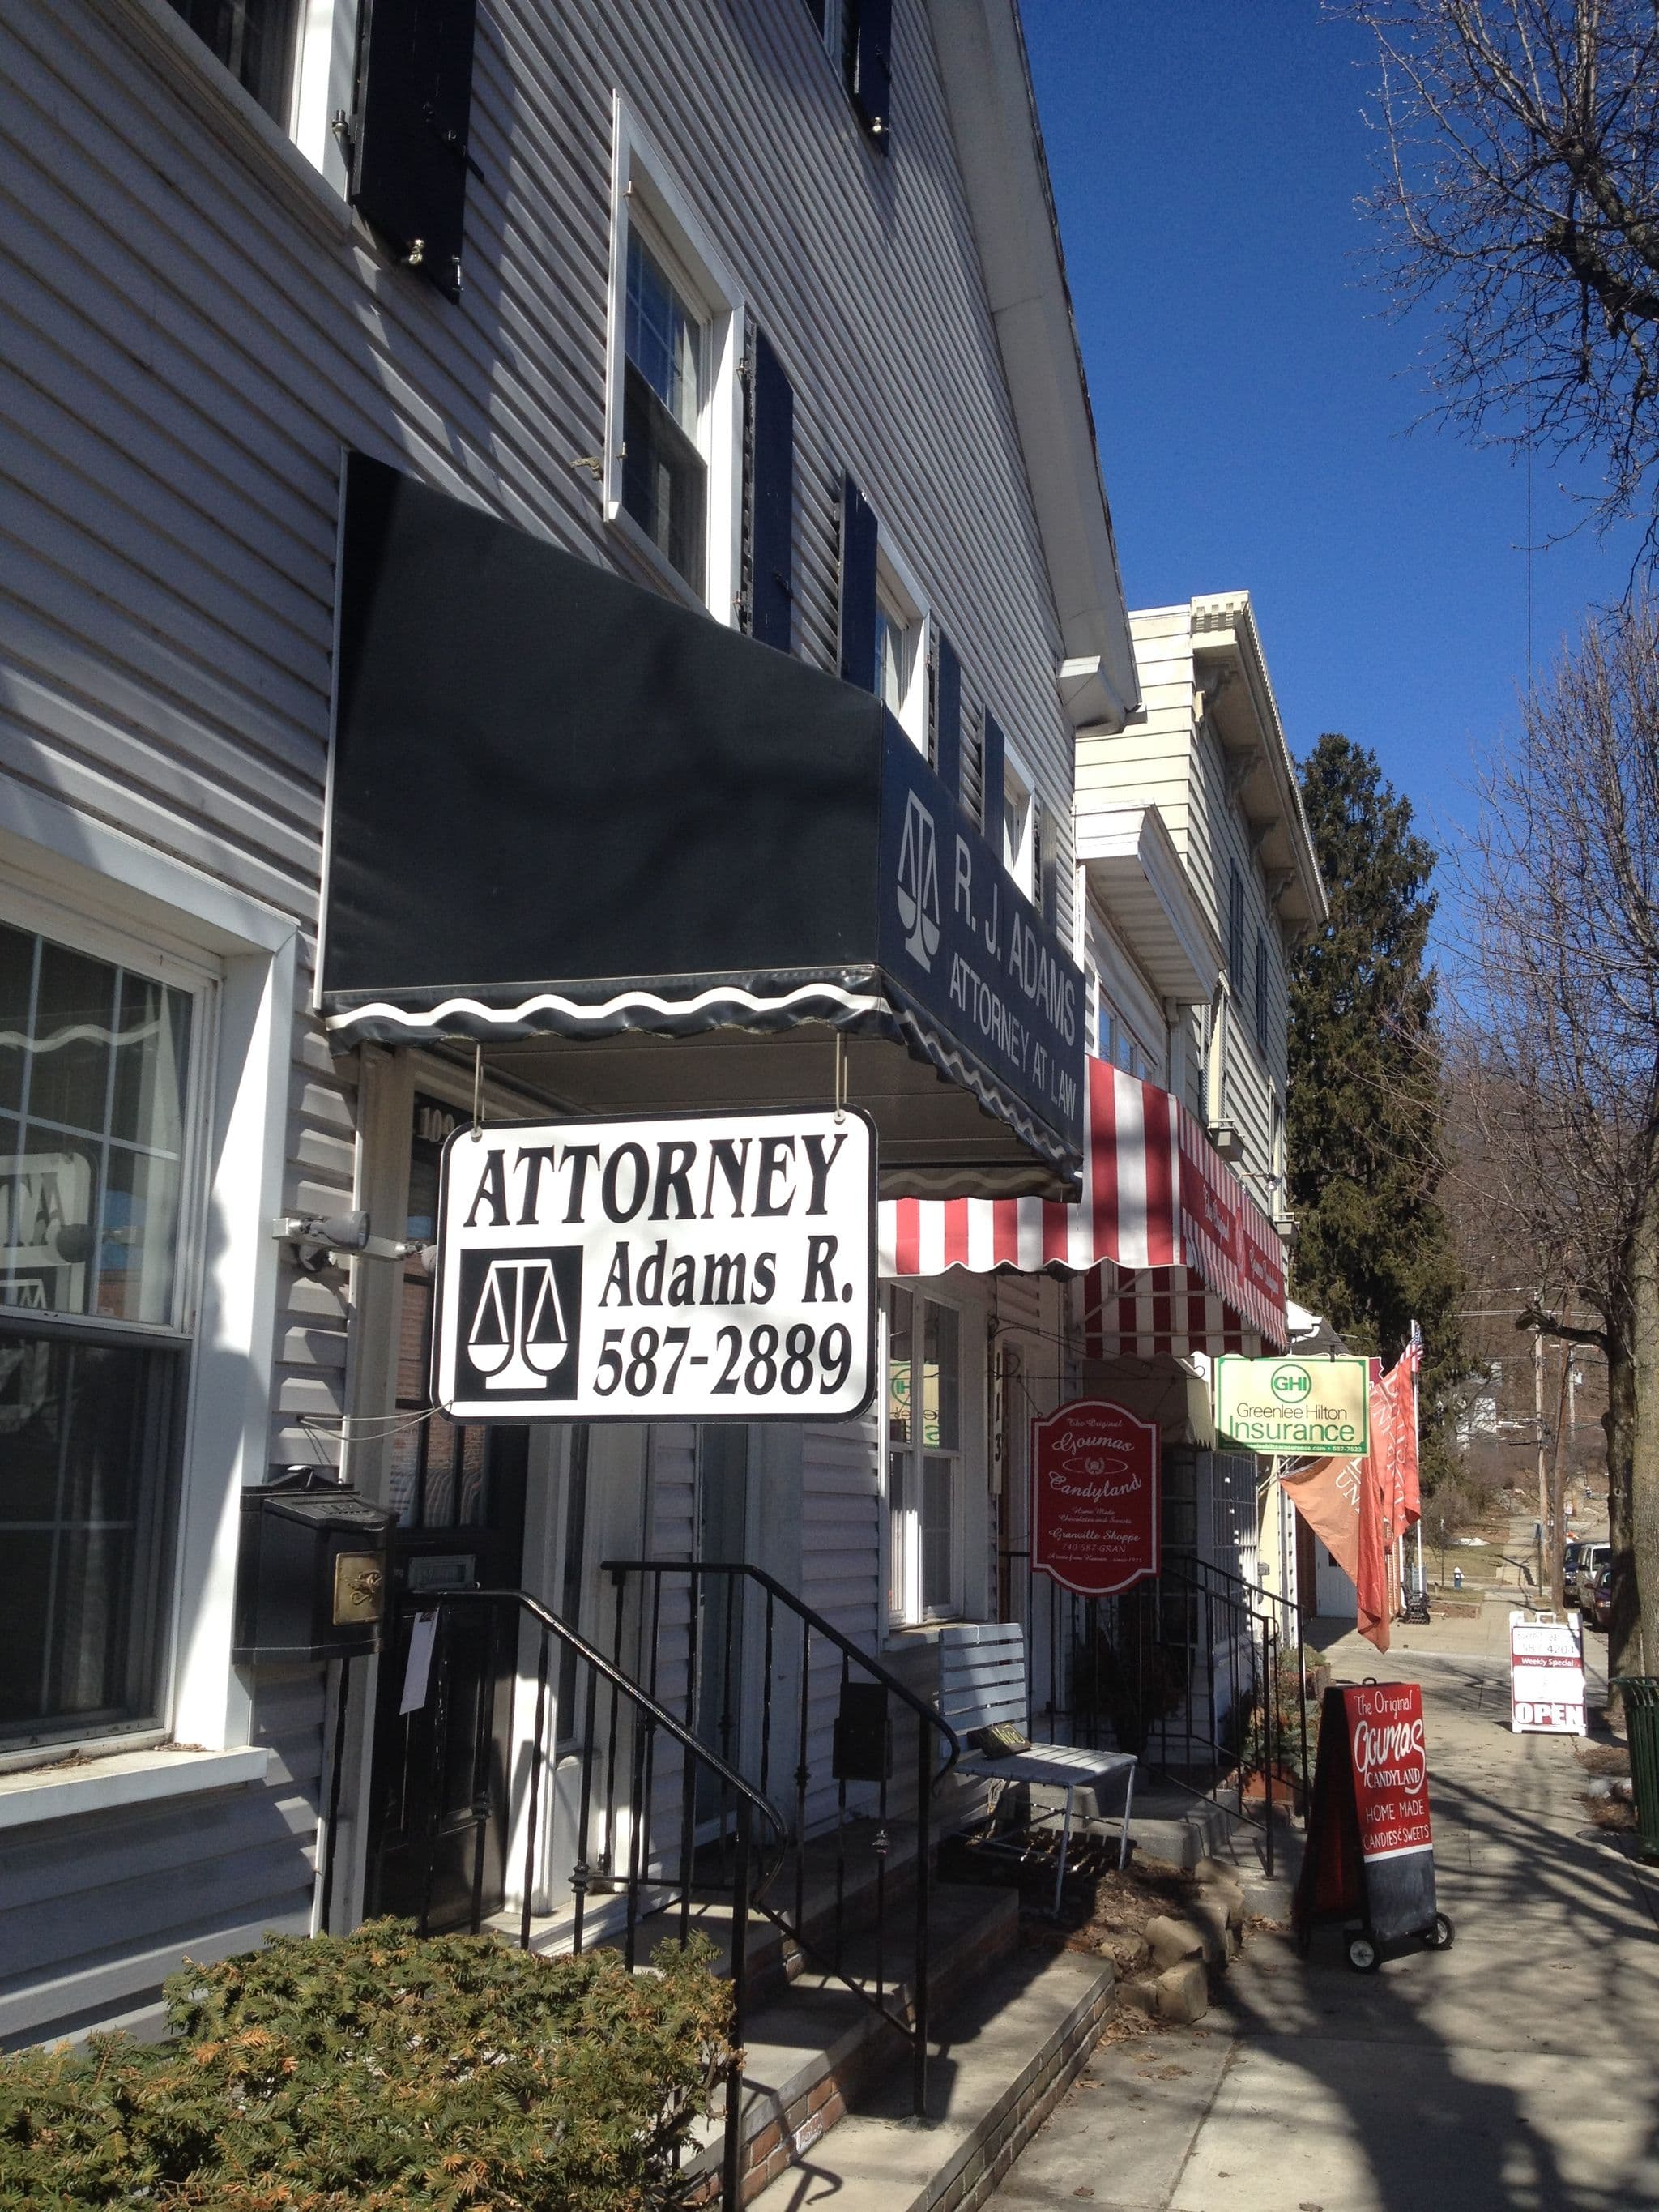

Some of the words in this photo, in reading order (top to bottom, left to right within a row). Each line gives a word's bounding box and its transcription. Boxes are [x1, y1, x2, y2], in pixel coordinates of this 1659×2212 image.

[954, 832, 977, 933] R.
[984, 882, 1001, 963] J.
[1008, 911, 1077, 1048] ADAMS
[949, 951, 1030, 1074] ATTORNEY
[1031, 1040, 1048, 1093] AT
[1051, 1060, 1077, 1121] LAW
[462, 1133, 849, 1227] ATTORNEY
[597, 1238, 778, 1307] Adams
[800, 1234, 854, 1304] R.
[592, 1322, 853, 1397] 587-2889
[1273, 1375, 1307, 1392] GHI
[1066, 1418, 1085, 1428] The
[1085, 1418, 1124, 1429] Original
[1236, 1402, 1303, 1420] Greenlee
[1305, 1403, 1348, 1421] Hilton
[1229, 1415, 1356, 1442] Insurance
[1051, 1431, 1135, 1456] Goumas
[1048, 1471, 1142, 1504] Candyland
[1048, 1527, 1101, 1541] Granville
[1102, 1529, 1141, 1544] Shoppe
[1521, 1658, 1548, 1668] Weekly
[1548, 1658, 1574, 1668] Special
[1354, 1693, 1372, 1716] The
[1374, 1689, 1413, 1719] Original
[1516, 1703, 1584, 1725] OPEN
[1354, 1718, 1427, 1795] Goumas
[1366, 1767, 1422, 1790] CANDYLAND
[1366, 1803, 1396, 1823] HOME
[1399, 1799, 1425, 1818] MADE
[1363, 1829, 1398, 1851] CANDIES
[1402, 1824, 1431, 1843] SWEETS
